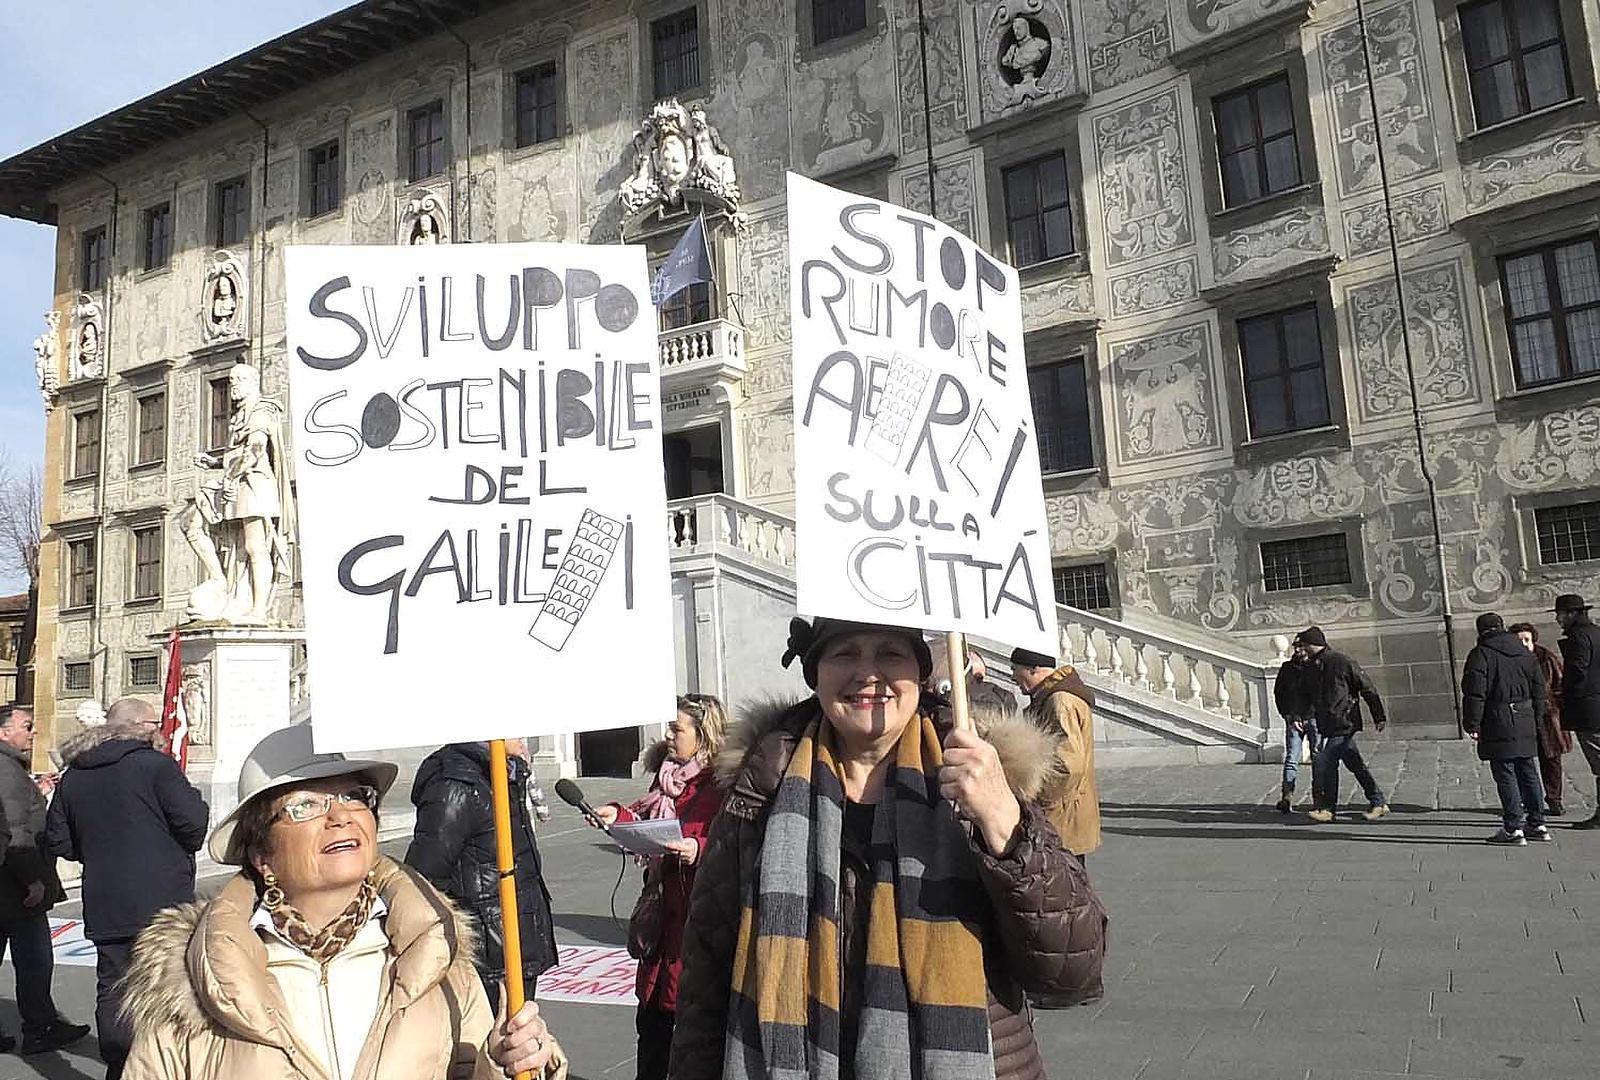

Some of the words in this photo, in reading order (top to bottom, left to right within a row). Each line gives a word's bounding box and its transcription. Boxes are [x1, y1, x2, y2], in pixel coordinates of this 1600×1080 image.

[830, 202, 1008, 311] STOP
[296, 266, 639, 371] SVILUPPO
[801, 259, 1007, 387] RUMORE
[304, 353, 654, 467] SOSTENIBILE
[428, 460, 587, 505] DEL
[824, 471, 980, 541] SULLA
